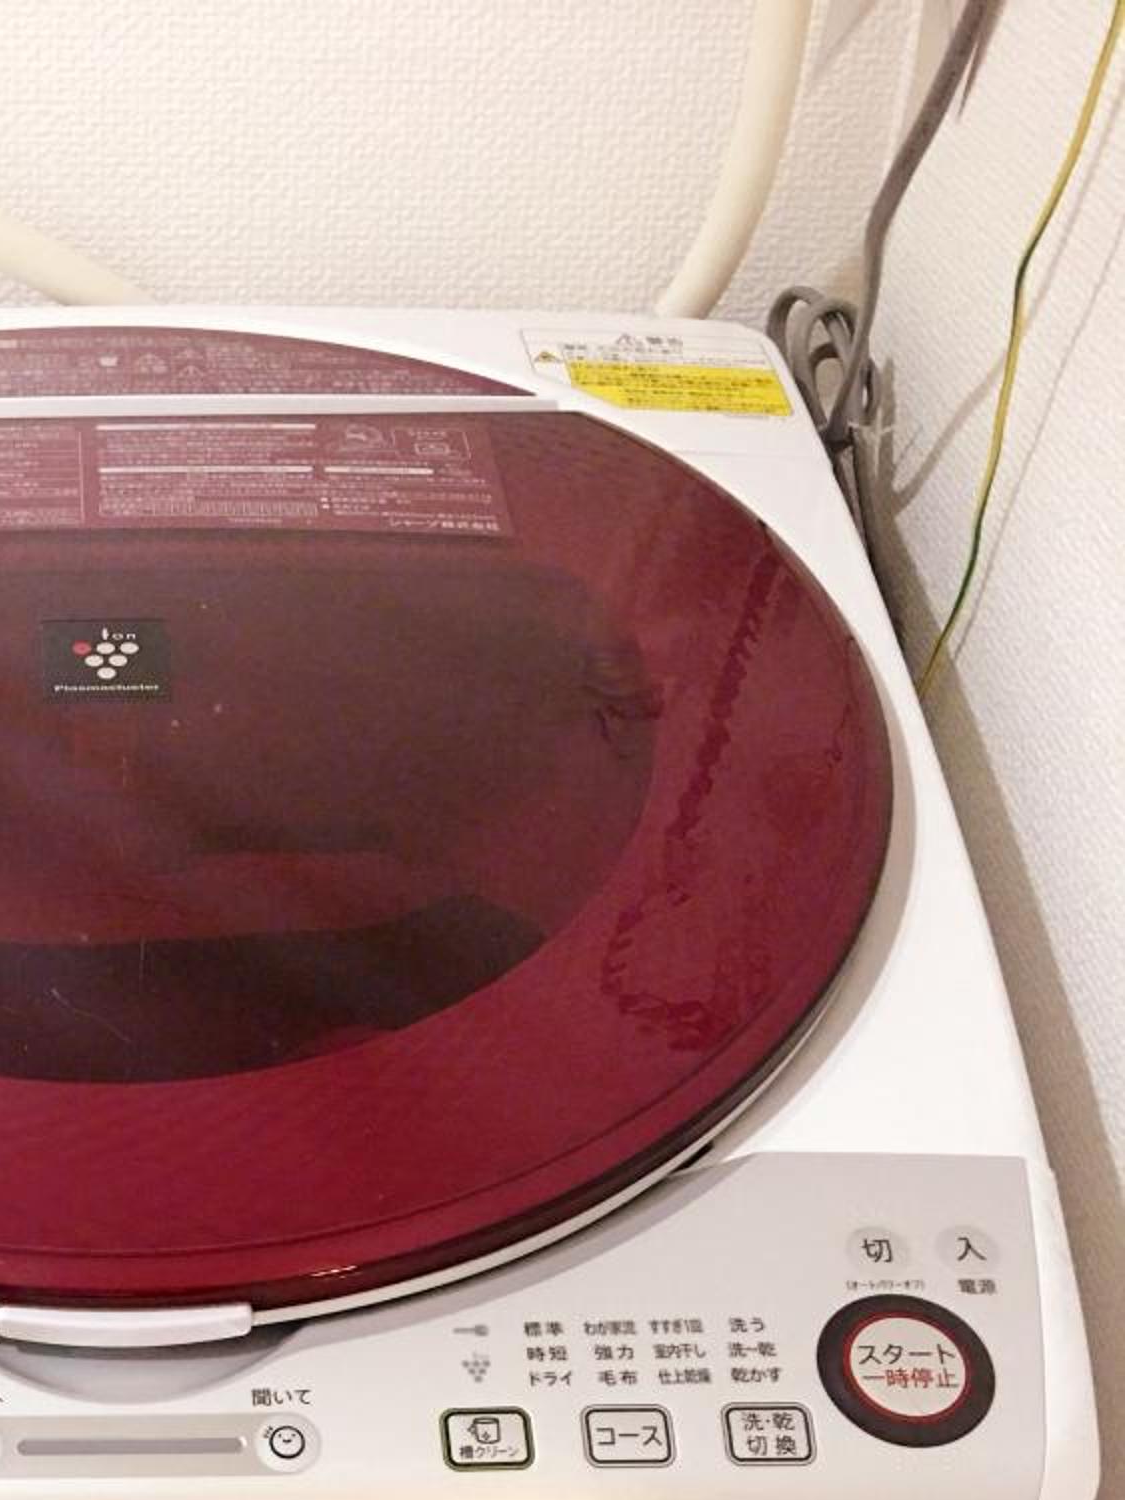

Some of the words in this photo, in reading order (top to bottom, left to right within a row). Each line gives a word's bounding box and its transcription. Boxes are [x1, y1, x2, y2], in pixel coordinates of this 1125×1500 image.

[862, 1238, 892, 1263] 切
[957, 1237, 986, 1262] 入
[958, 1278, 997, 1295] 電源
[523, 1321, 565, 1337] 標準
[583, 1320, 637, 1336] わが家流
[729, 1318, 766, 1334] 洗う
[527, 1346, 569, 1362] 時短
[595, 1345, 634, 1360] 強力
[653, 1344, 706, 1360] 室内干し
[858, 1343, 956, 1365] スタート
[528, 1371, 574, 1387] ドライ
[598, 1370, 639, 1386] 毛布
[730, 1367, 782, 1384] 乾かす
[863, 1368, 959, 1389] 一時停止
[252, 1388, 313, 1407] 聞いて
[596, 1425, 663, 1447] コース
[459, 1444, 520, 1460] 槽クリーン
[745, 1435, 797, 1456] 切換
